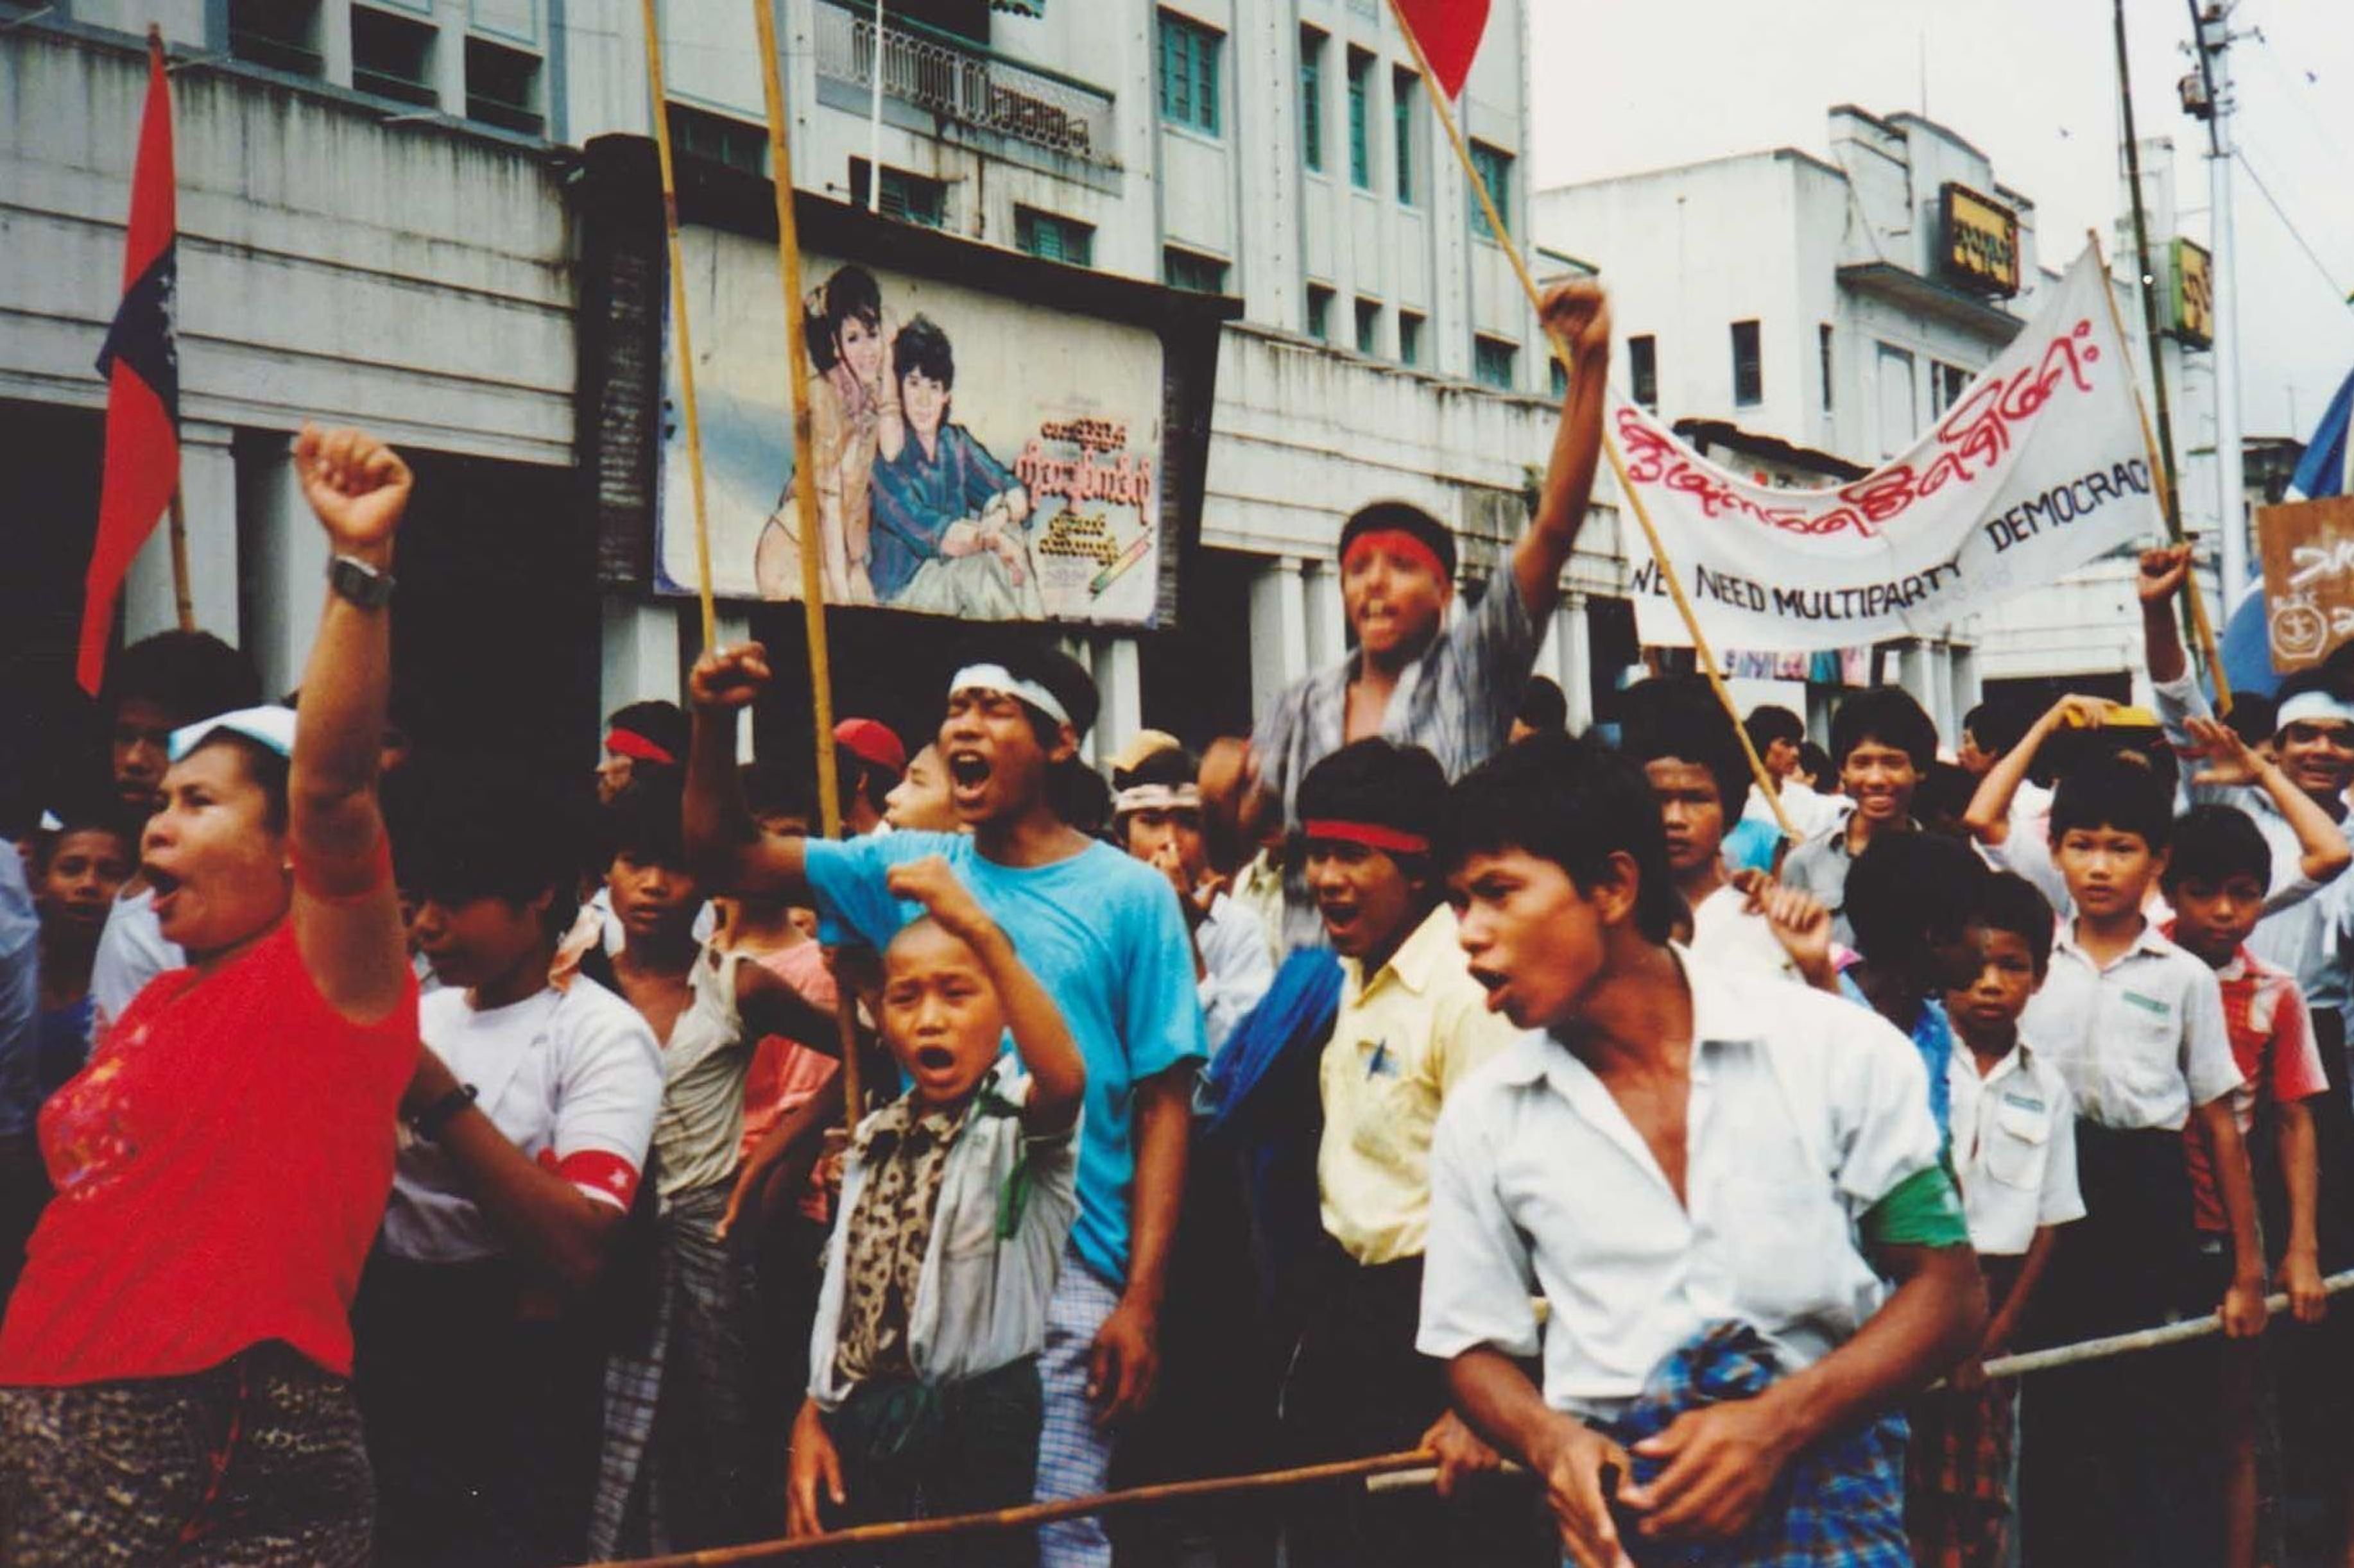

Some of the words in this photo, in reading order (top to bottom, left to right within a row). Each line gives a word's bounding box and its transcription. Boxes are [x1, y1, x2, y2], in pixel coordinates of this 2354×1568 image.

[1696, 563, 1765, 612] NEED
[1772, 557, 1961, 620] MULTIPARTY
[1984, 458, 2149, 553] DEMOCRAC
